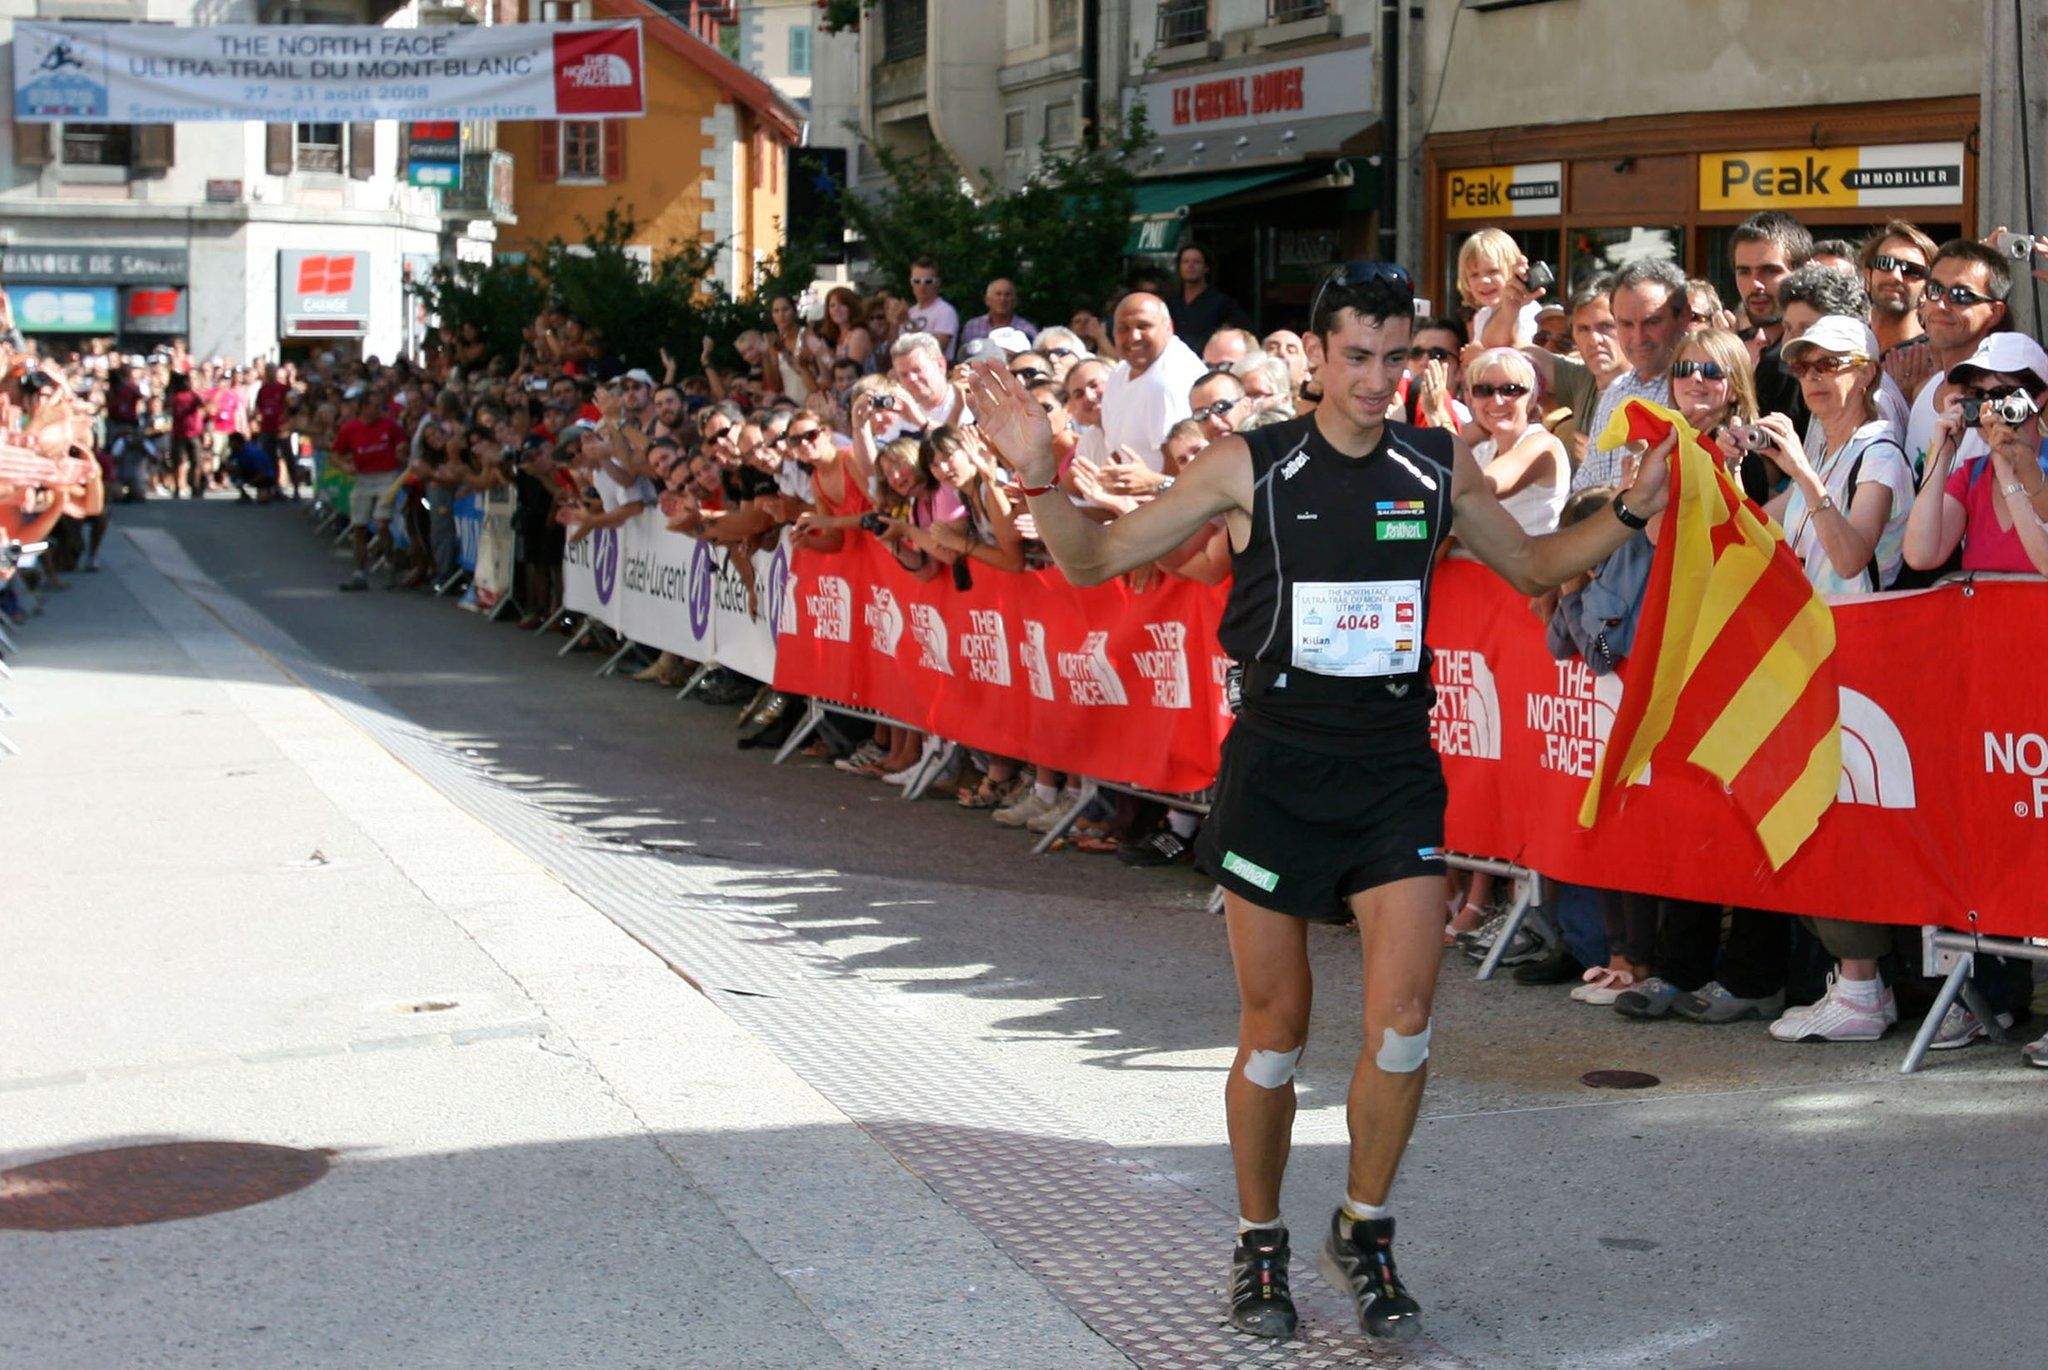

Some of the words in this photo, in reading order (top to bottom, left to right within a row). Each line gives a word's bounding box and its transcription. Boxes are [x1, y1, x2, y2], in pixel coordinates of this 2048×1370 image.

[217, 35, 269, 56] THE
[279, 35, 371, 56] NORTH
[129, 56, 303, 79] ULTRA-TRAIL
[310, 60, 349, 79] DU
[378, 84, 429, 100] 2008
[1451, 173, 1502, 208] Peak
[1722, 156, 1832, 198] Peak
[1853, 169, 1948, 187] IMMOBILIER
[88, 254, 116, 275] DE
[1144, 621, 1179, 652] THE
[1336, 614, 1380, 631] 4048
[1434, 649, 1472, 685] THE
[1555, 659, 1594, 700] THE
[1429, 684, 1472, 721] RTH
[1526, 692, 1594, 739] NORTH
